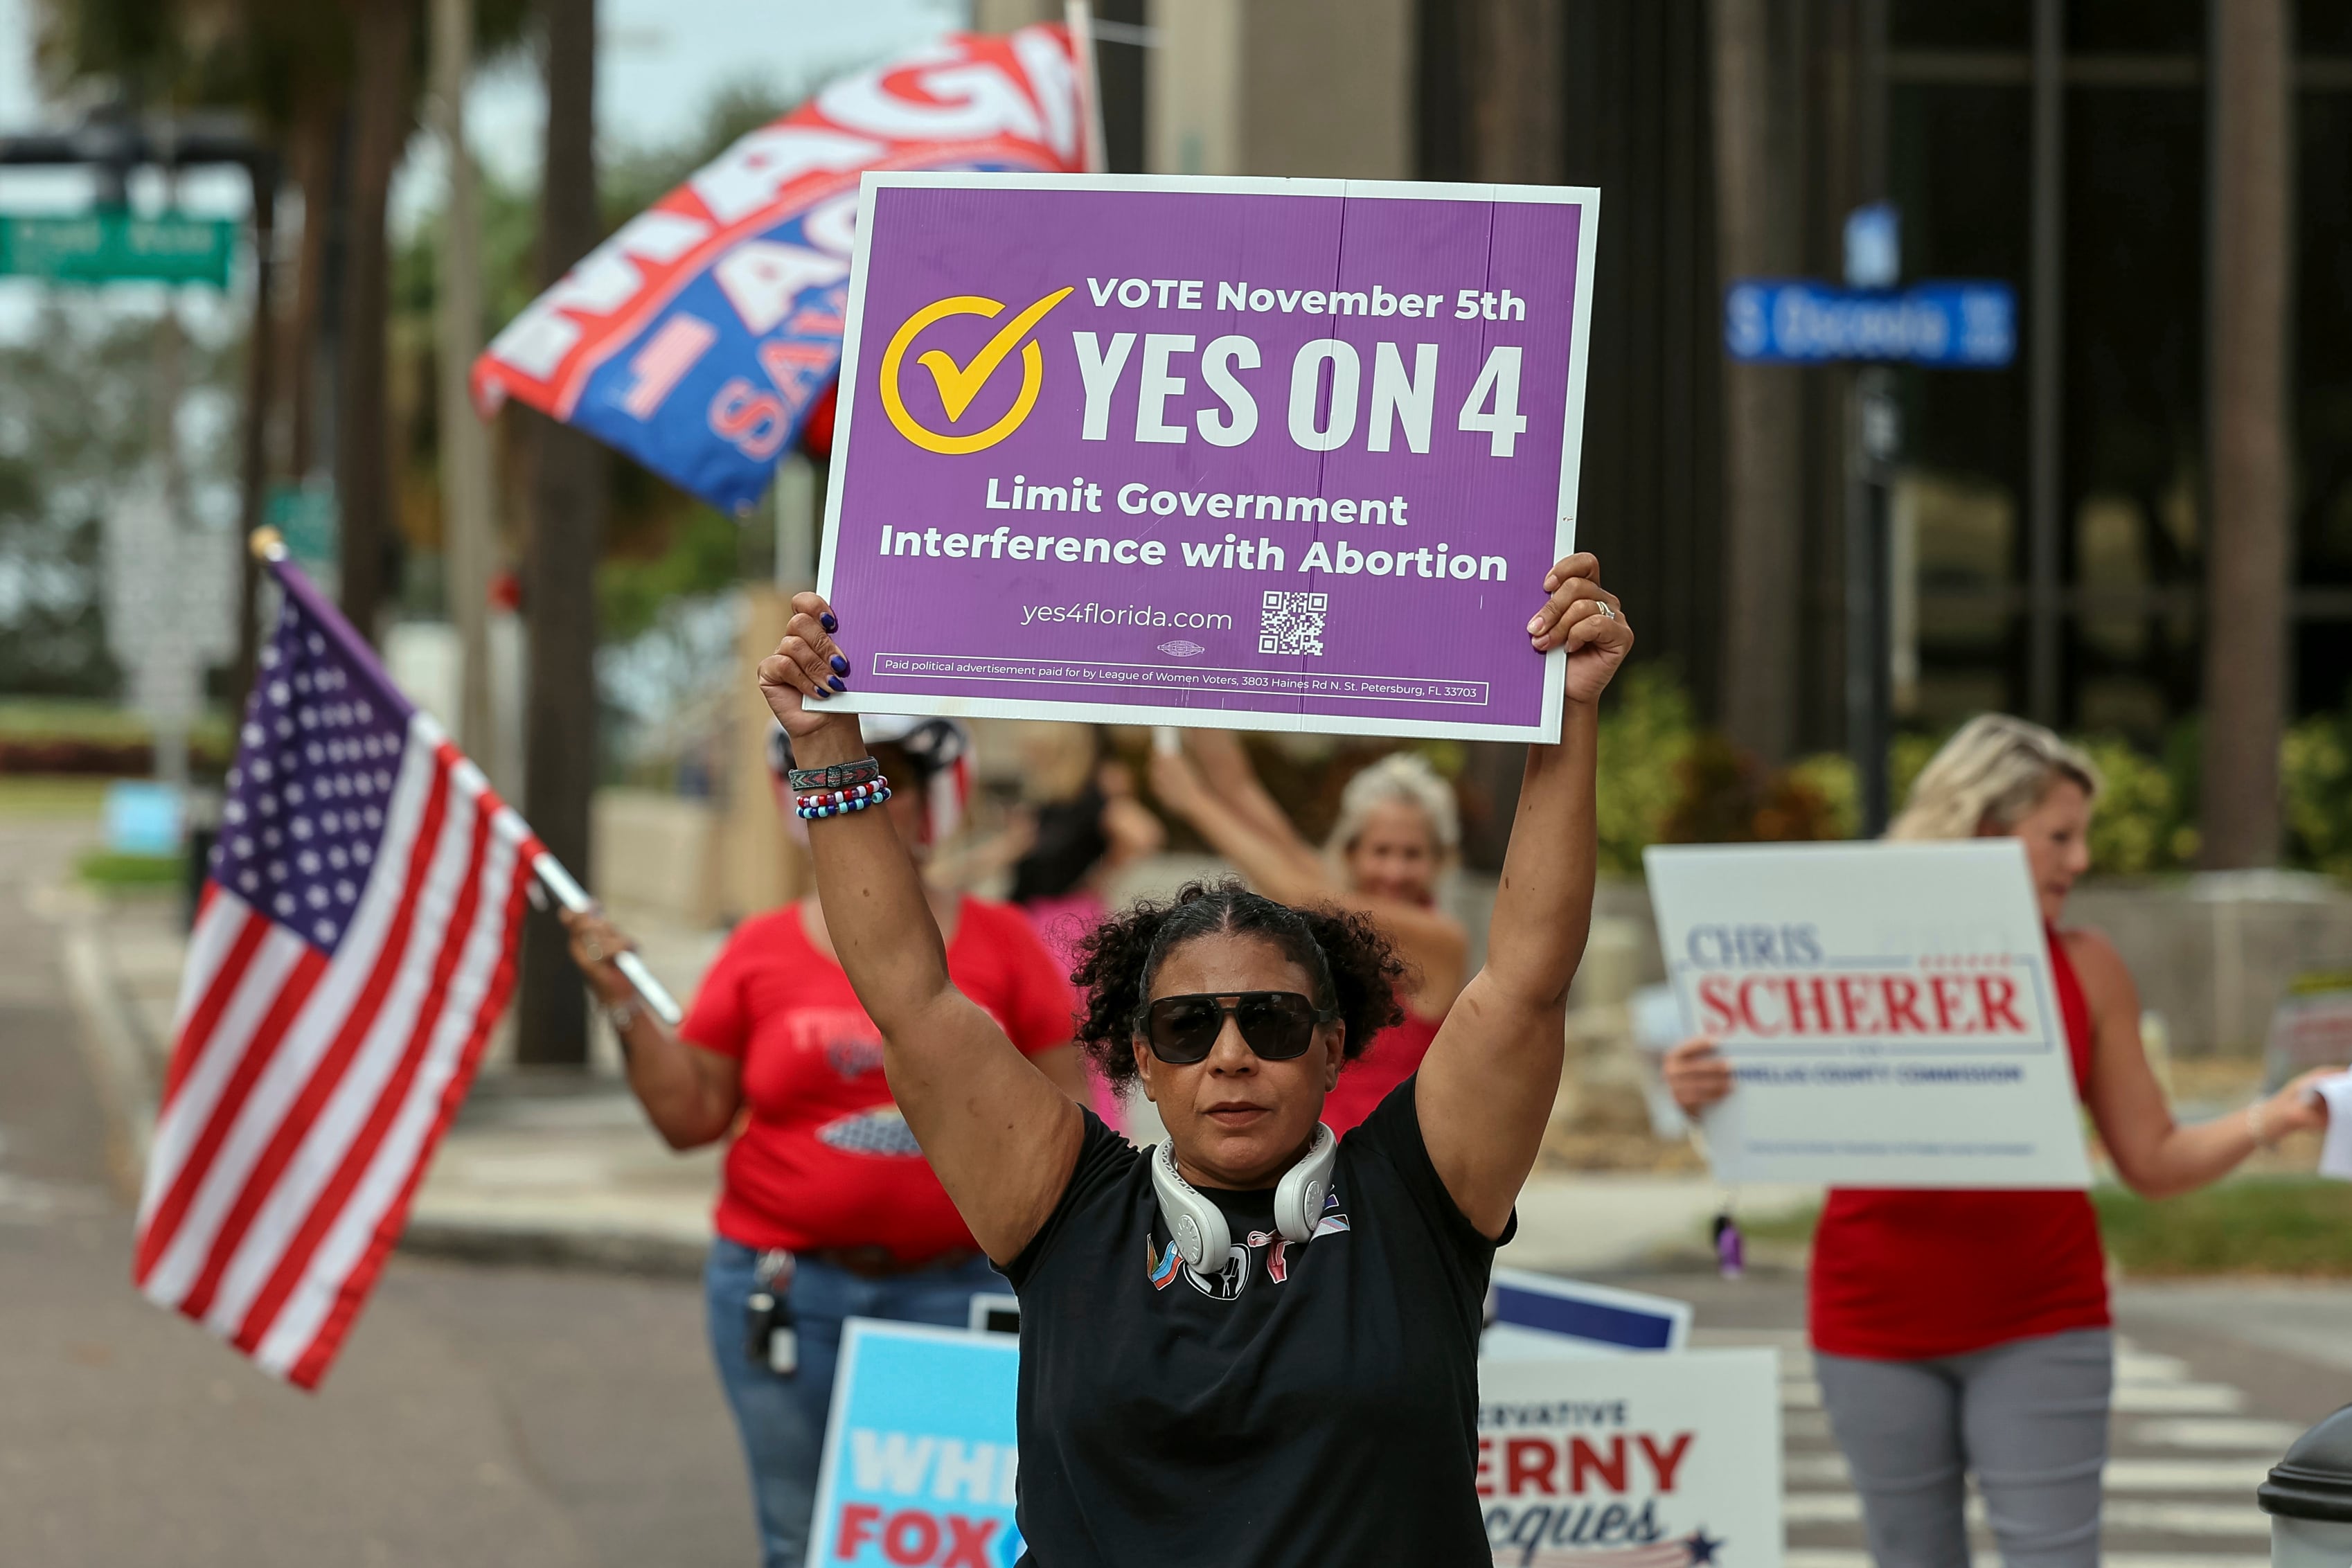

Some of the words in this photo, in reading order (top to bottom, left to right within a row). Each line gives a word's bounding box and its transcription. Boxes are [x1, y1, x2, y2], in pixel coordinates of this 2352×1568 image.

[1086, 278, 1204, 310] VOTE
[1217, 281, 1444, 318] November
[1454, 289, 1526, 321] 5th
[1072, 331, 1261, 447] YES
[1288, 339, 1438, 454] ON
[1458, 346, 1527, 457] 4
[986, 474, 1103, 513] Limit
[1117, 483, 1408, 526] Government
[880, 524, 1166, 566] Interference
[1180, 533, 1285, 571] with
[1298, 541, 1507, 581] Abortion
[1020, 603, 1232, 630] yes4florida.com
[885, 659, 909, 669] Paid
[911, 661, 954, 671] political
[956, 663, 1035, 675] advertisement
[1038, 666, 1062, 677] paid
[1065, 667, 1080, 677] for
[1083, 668, 1096, 680] by
[1099, 669, 1139, 681] League
[1141, 671, 1154, 681] of
[1156, 672, 1200, 683] Women
[1202, 675, 1239, 686] Voters,
[1241, 676, 1269, 686] 3803
[1272, 678, 1309, 689] Haines
[1312, 680, 1327, 690] Rd
[1330, 681, 1342, 691] N.
[1344, 681, 1358, 692] St.
[1361, 682, 1425, 697] Petersburg,
[1428, 686, 1442, 695] FL
[1444, 686, 1477, 697] 33703
[1686, 922, 1824, 967] CHRIS
[1698, 975, 2028, 1037] SCHERER
[835, 1502, 1001, 1568] FOX
